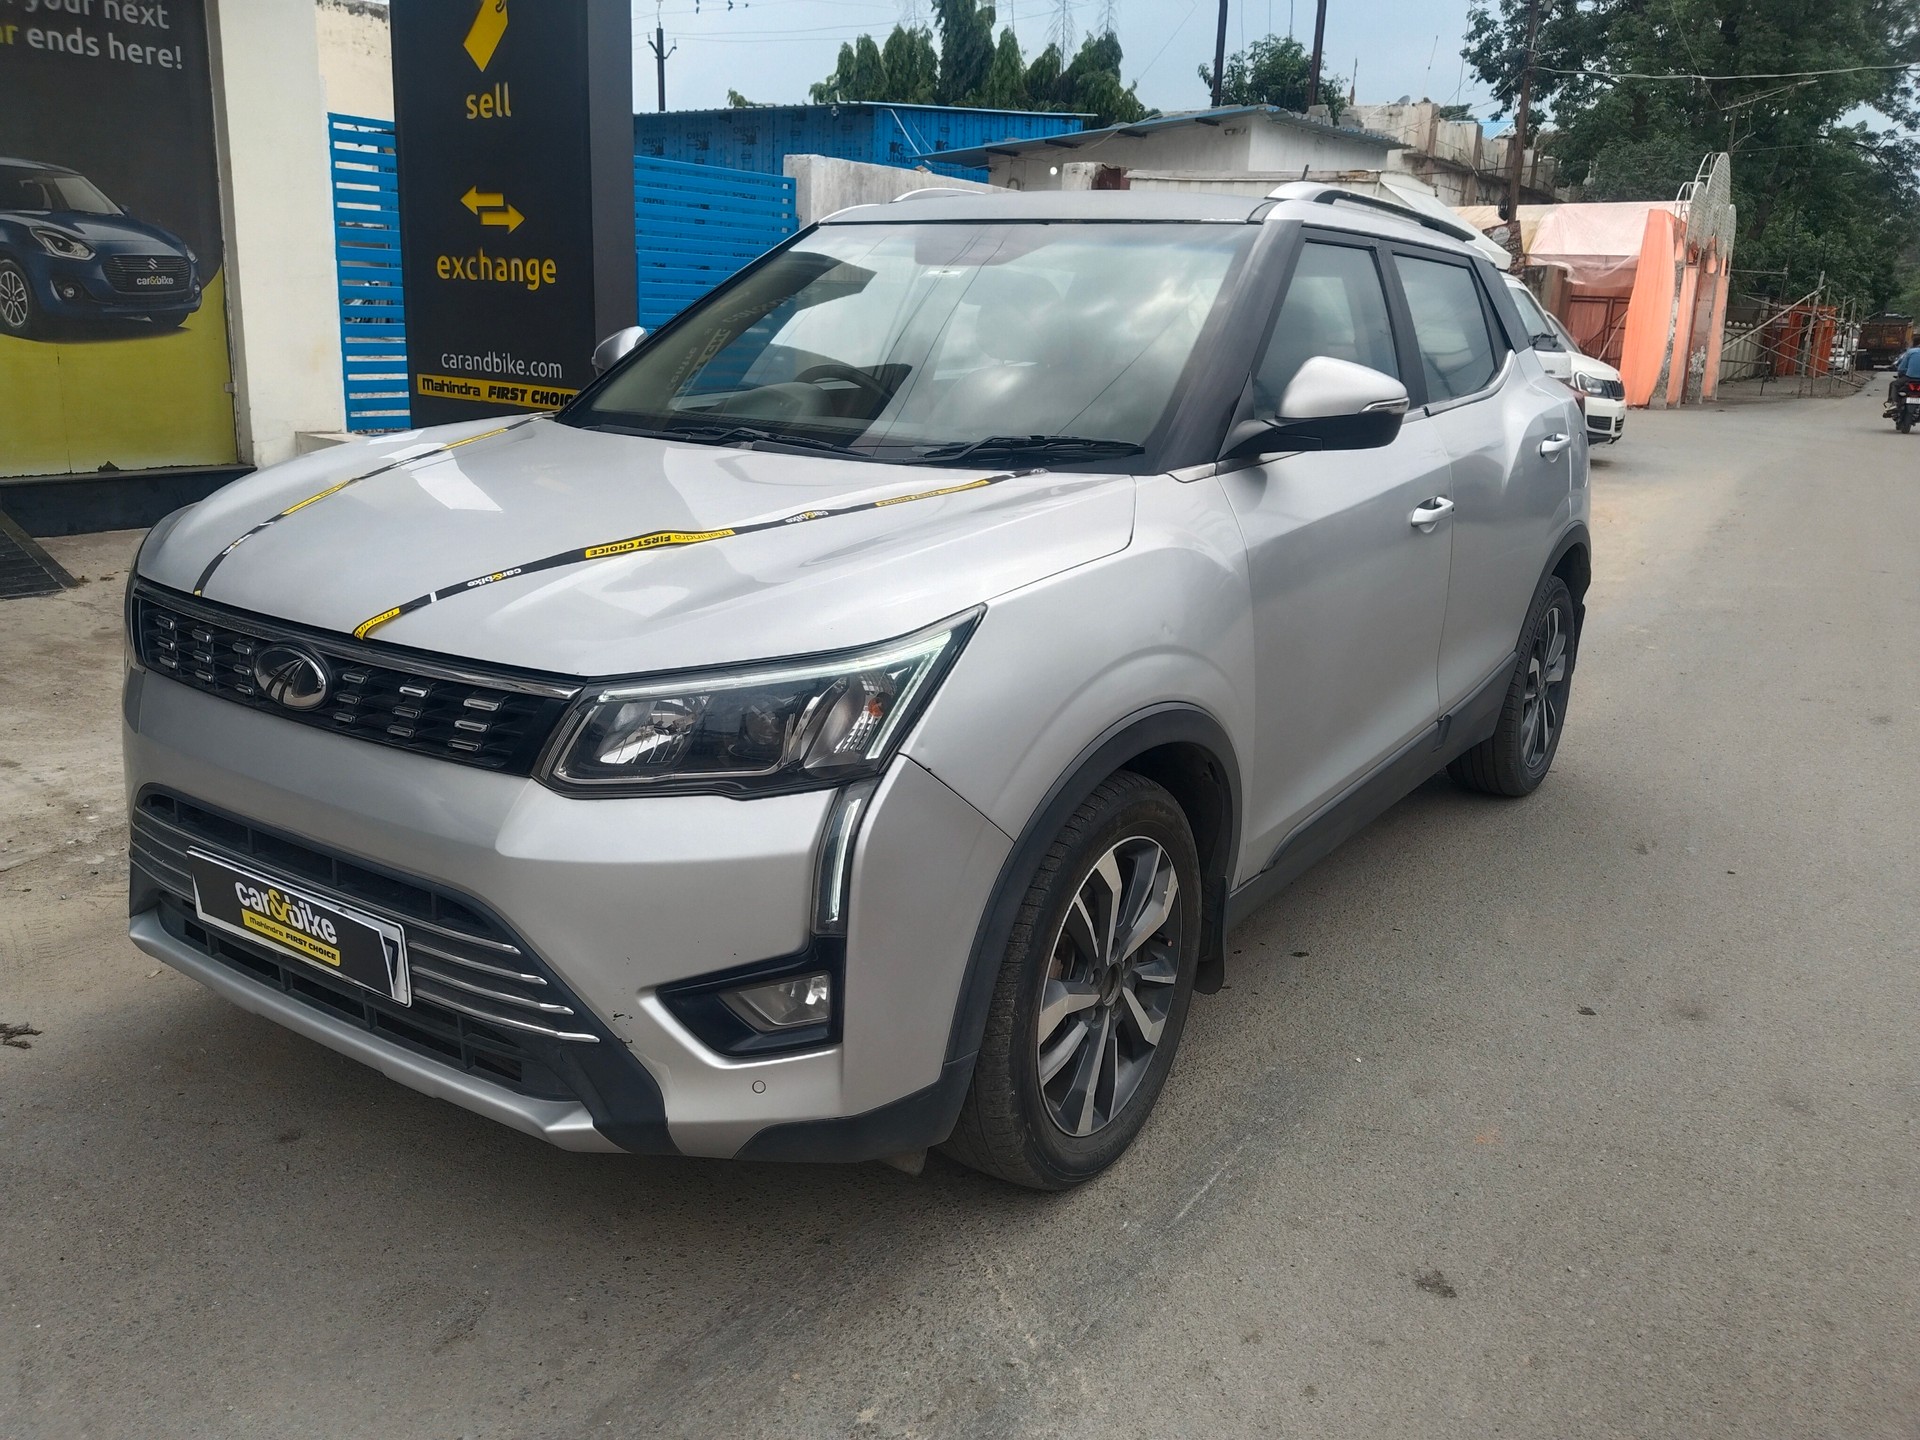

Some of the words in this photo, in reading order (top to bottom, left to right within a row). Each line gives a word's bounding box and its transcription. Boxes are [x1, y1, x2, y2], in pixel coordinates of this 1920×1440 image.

[104, 0, 170, 30] next
[27, 27, 100, 57] ends
[108, 32, 183, 70] here!
[465, 81, 512, 120] sell
[436, 247, 557, 291] exchange
[441, 351, 563, 379] carandbike.com
[488, 385, 527, 402] FIRST
[531, 389, 576, 407] CHOIC
[590, 542, 635, 556] CHOICE
[637, 534, 672, 548] FIRST
[467, 567, 522, 587] car&bike
[234, 881, 338, 945] car&bike
[286, 932, 308, 948] FIRST
[308, 942, 337, 961] CHOICE
